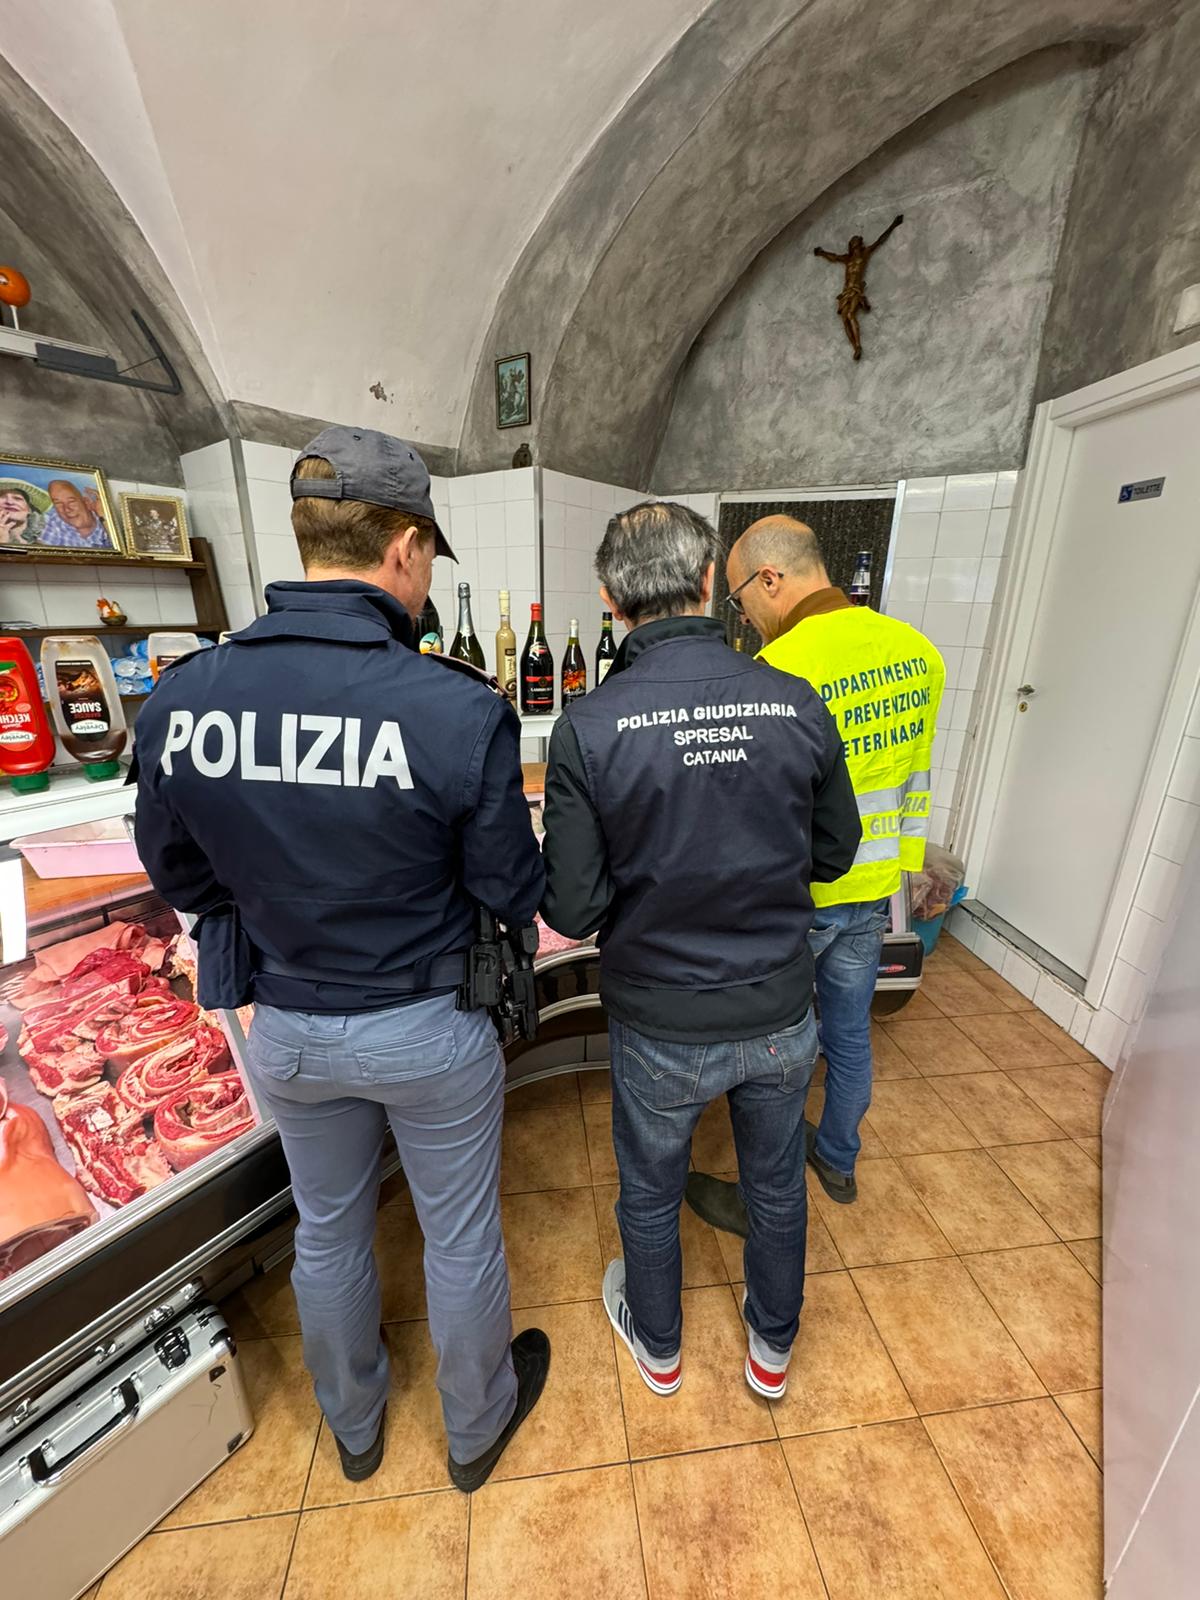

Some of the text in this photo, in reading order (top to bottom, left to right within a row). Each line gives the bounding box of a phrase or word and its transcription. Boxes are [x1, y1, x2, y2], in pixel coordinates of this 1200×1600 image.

[820, 657, 928, 704] DIPARTIMENTO
[68, 702, 102, 714] SAUCE
[617, 702, 797, 732] POLIZIA GIUDIZIARIA
[160, 710, 415, 790] POLIZIA
[674, 726, 753, 746] SPRESAL
[842, 717, 924, 760] ETERINARA
[683, 748, 747, 766] CATANIA
